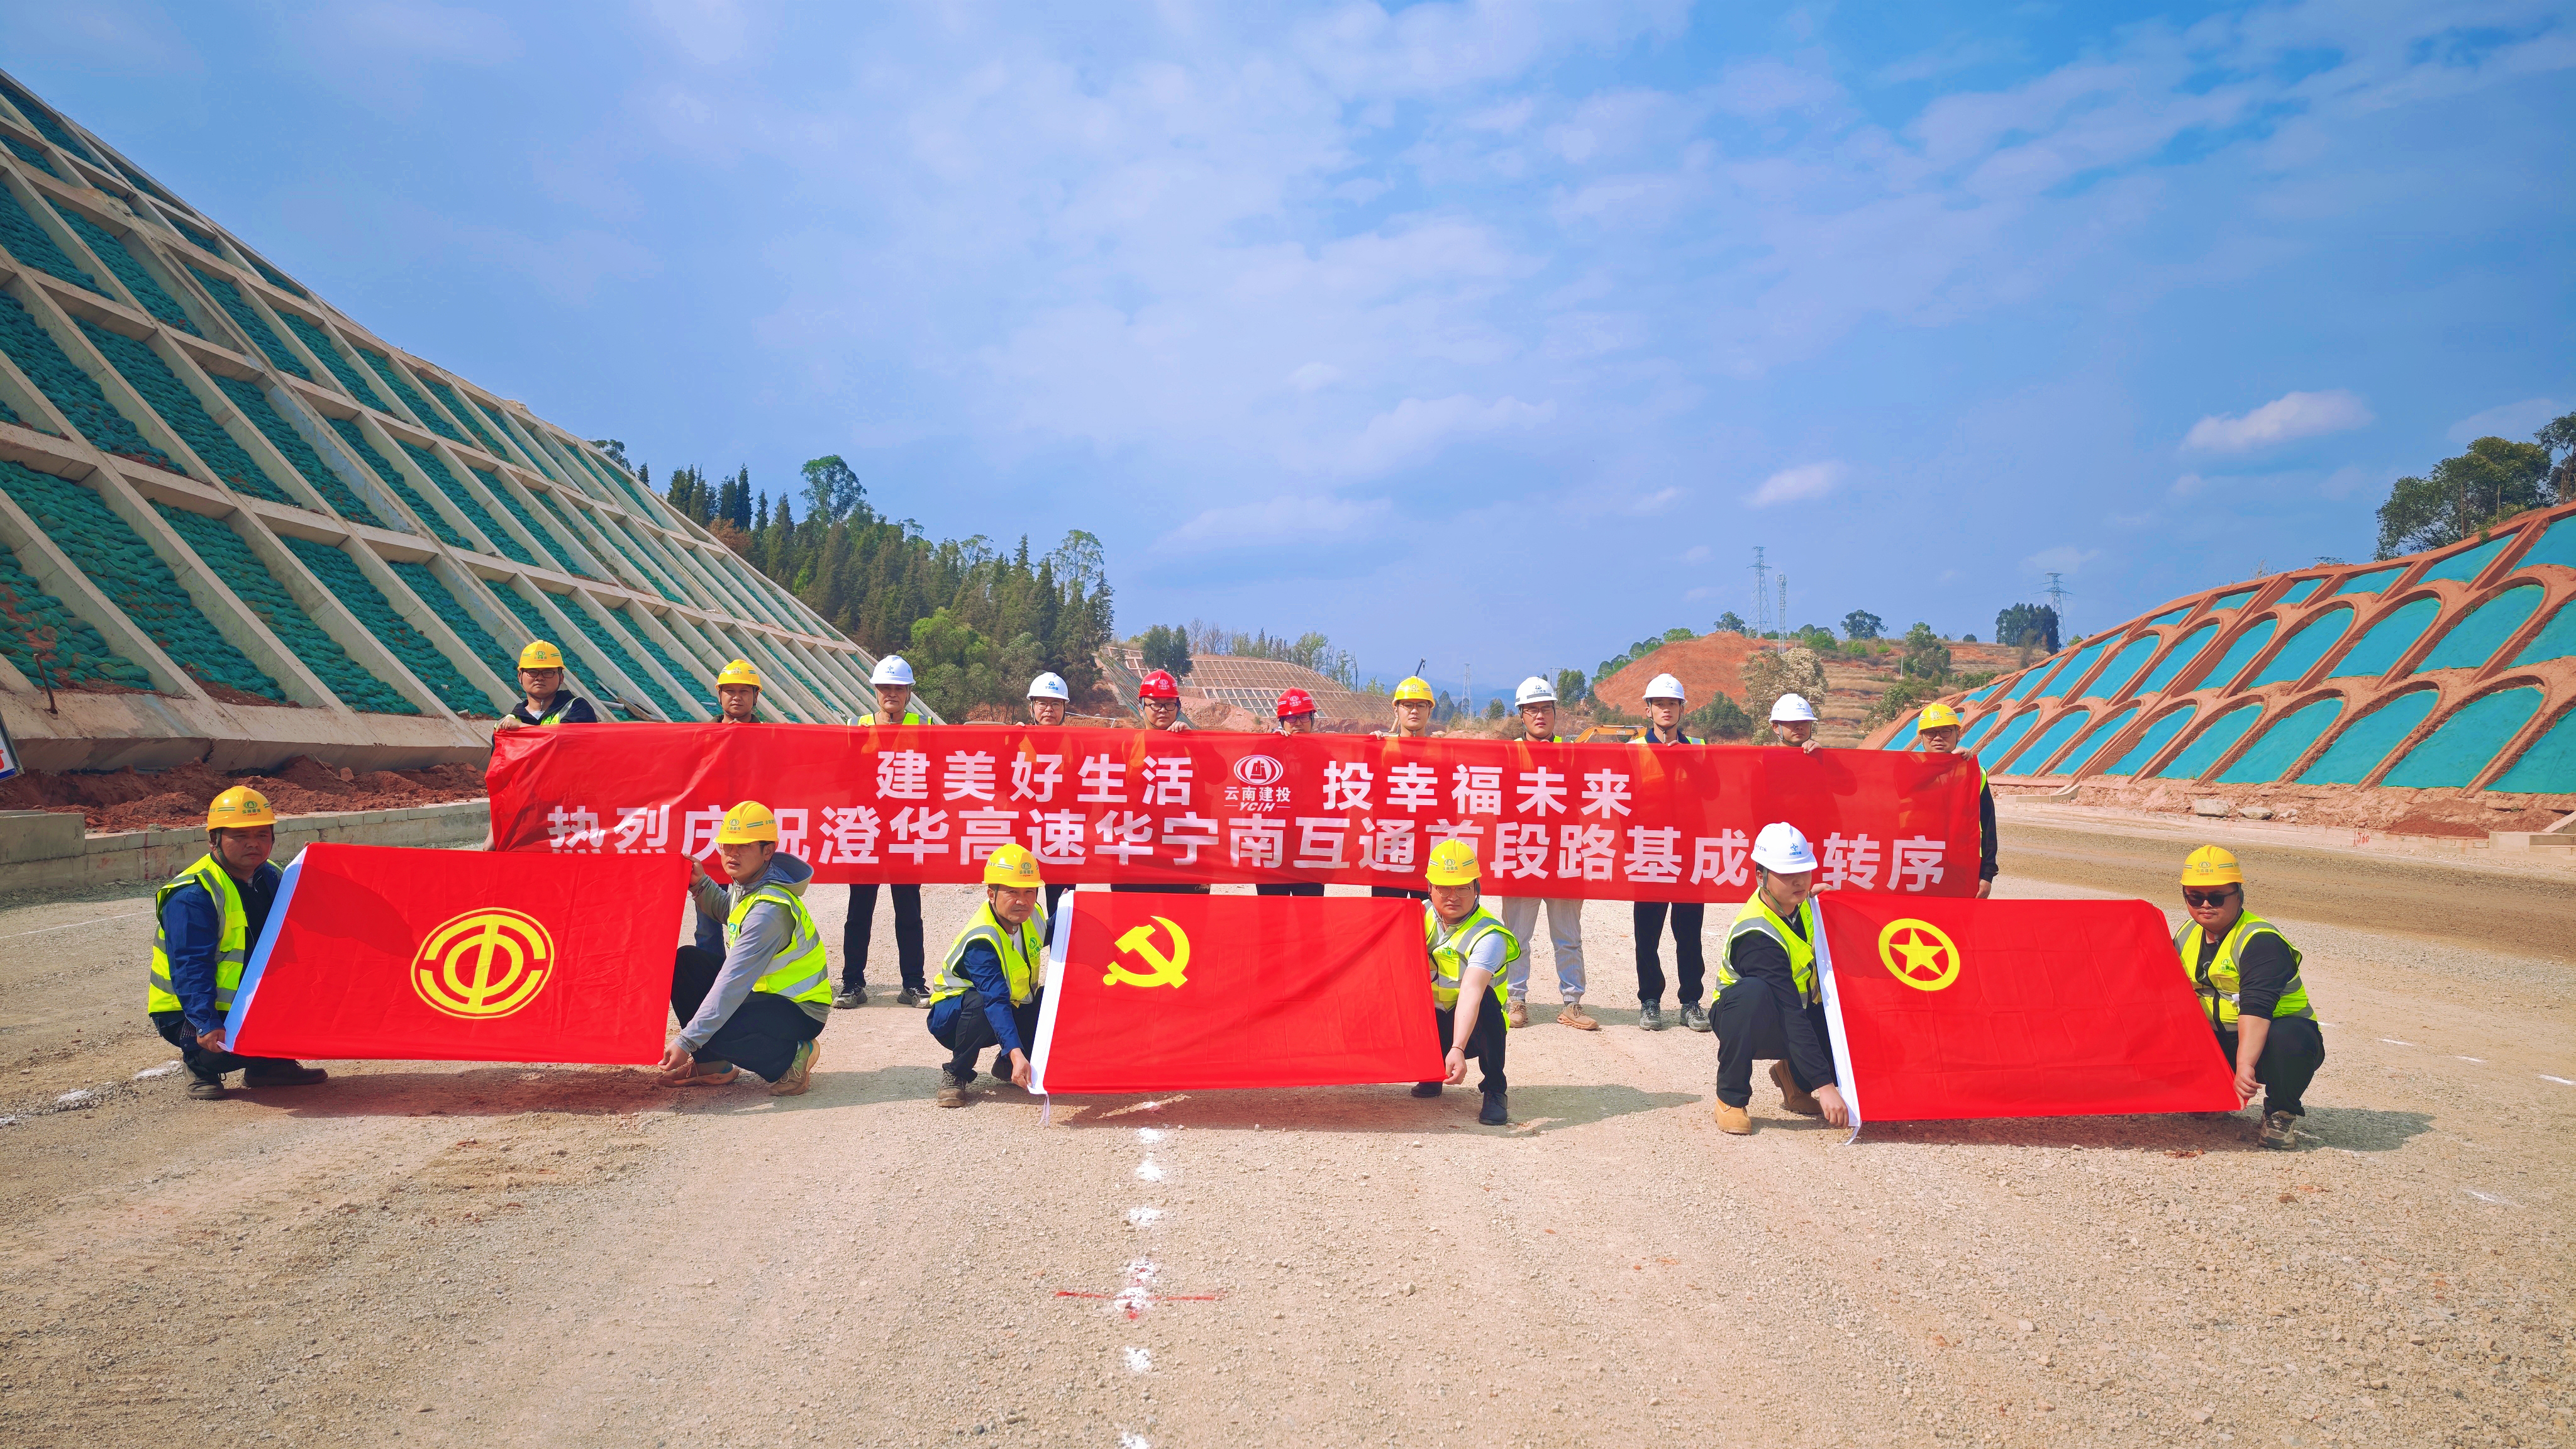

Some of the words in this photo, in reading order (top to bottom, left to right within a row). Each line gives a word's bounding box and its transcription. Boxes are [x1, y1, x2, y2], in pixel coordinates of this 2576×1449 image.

[875, 748, 1194, 806] 建美好生活
[1322, 760, 1632, 819] 投幸福未来
[1224, 786, 1291, 802] 云南建投
[1239, 802, 1276, 811] YCIH
[547, 804, 1946, 892] 热烈庆澄华高速华宁南互通段路基成转序
